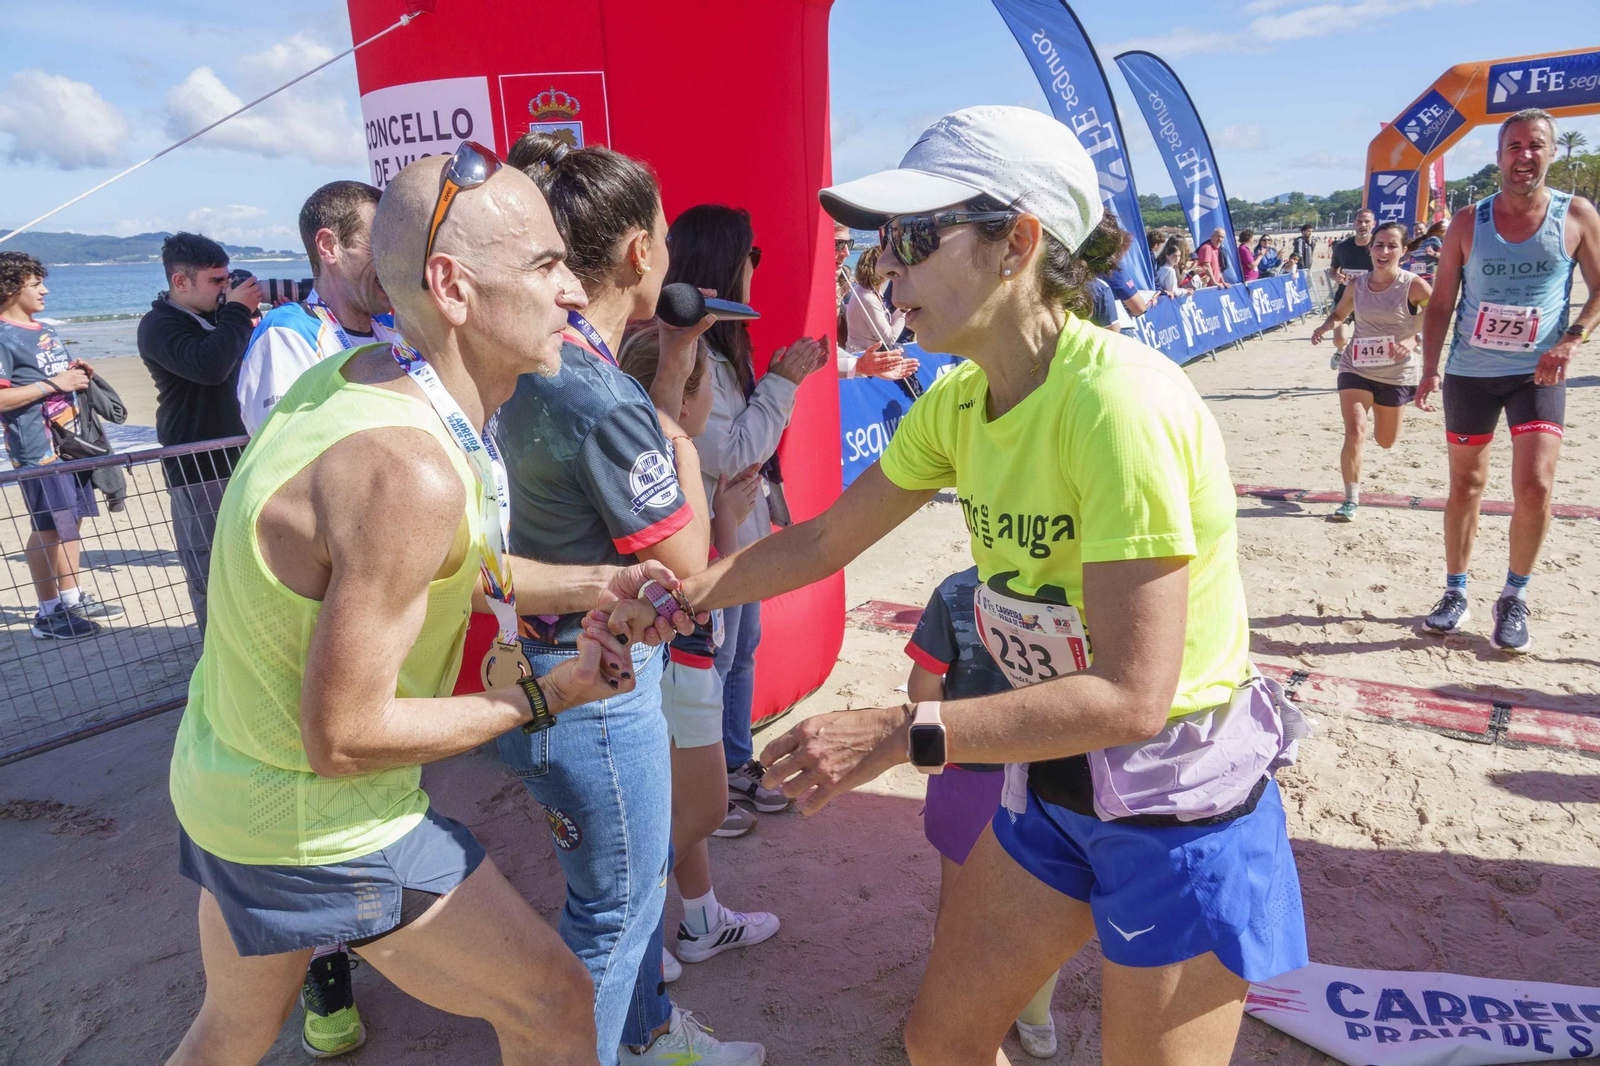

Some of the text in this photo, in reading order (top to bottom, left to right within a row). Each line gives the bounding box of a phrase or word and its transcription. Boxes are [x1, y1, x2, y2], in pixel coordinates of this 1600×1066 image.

[1526, 67, 1566, 94] FE
[365, 107, 474, 151] CONCELLO
[1416, 104, 1444, 127] FE
[1423, 107, 1455, 138] seguros
[374, 157, 391, 188] DE
[1485, 318, 1525, 336] 375
[1361, 345, 1385, 356] 414
[451, 411, 481, 453] CARREIRA
[980, 503, 994, 549] que
[997, 513, 1076, 560] auga
[995, 603, 1024, 621] CARREIRA
[990, 627, 1059, 681] 233
[1344, 1020, 1600, 1058] PRAIA DE S
